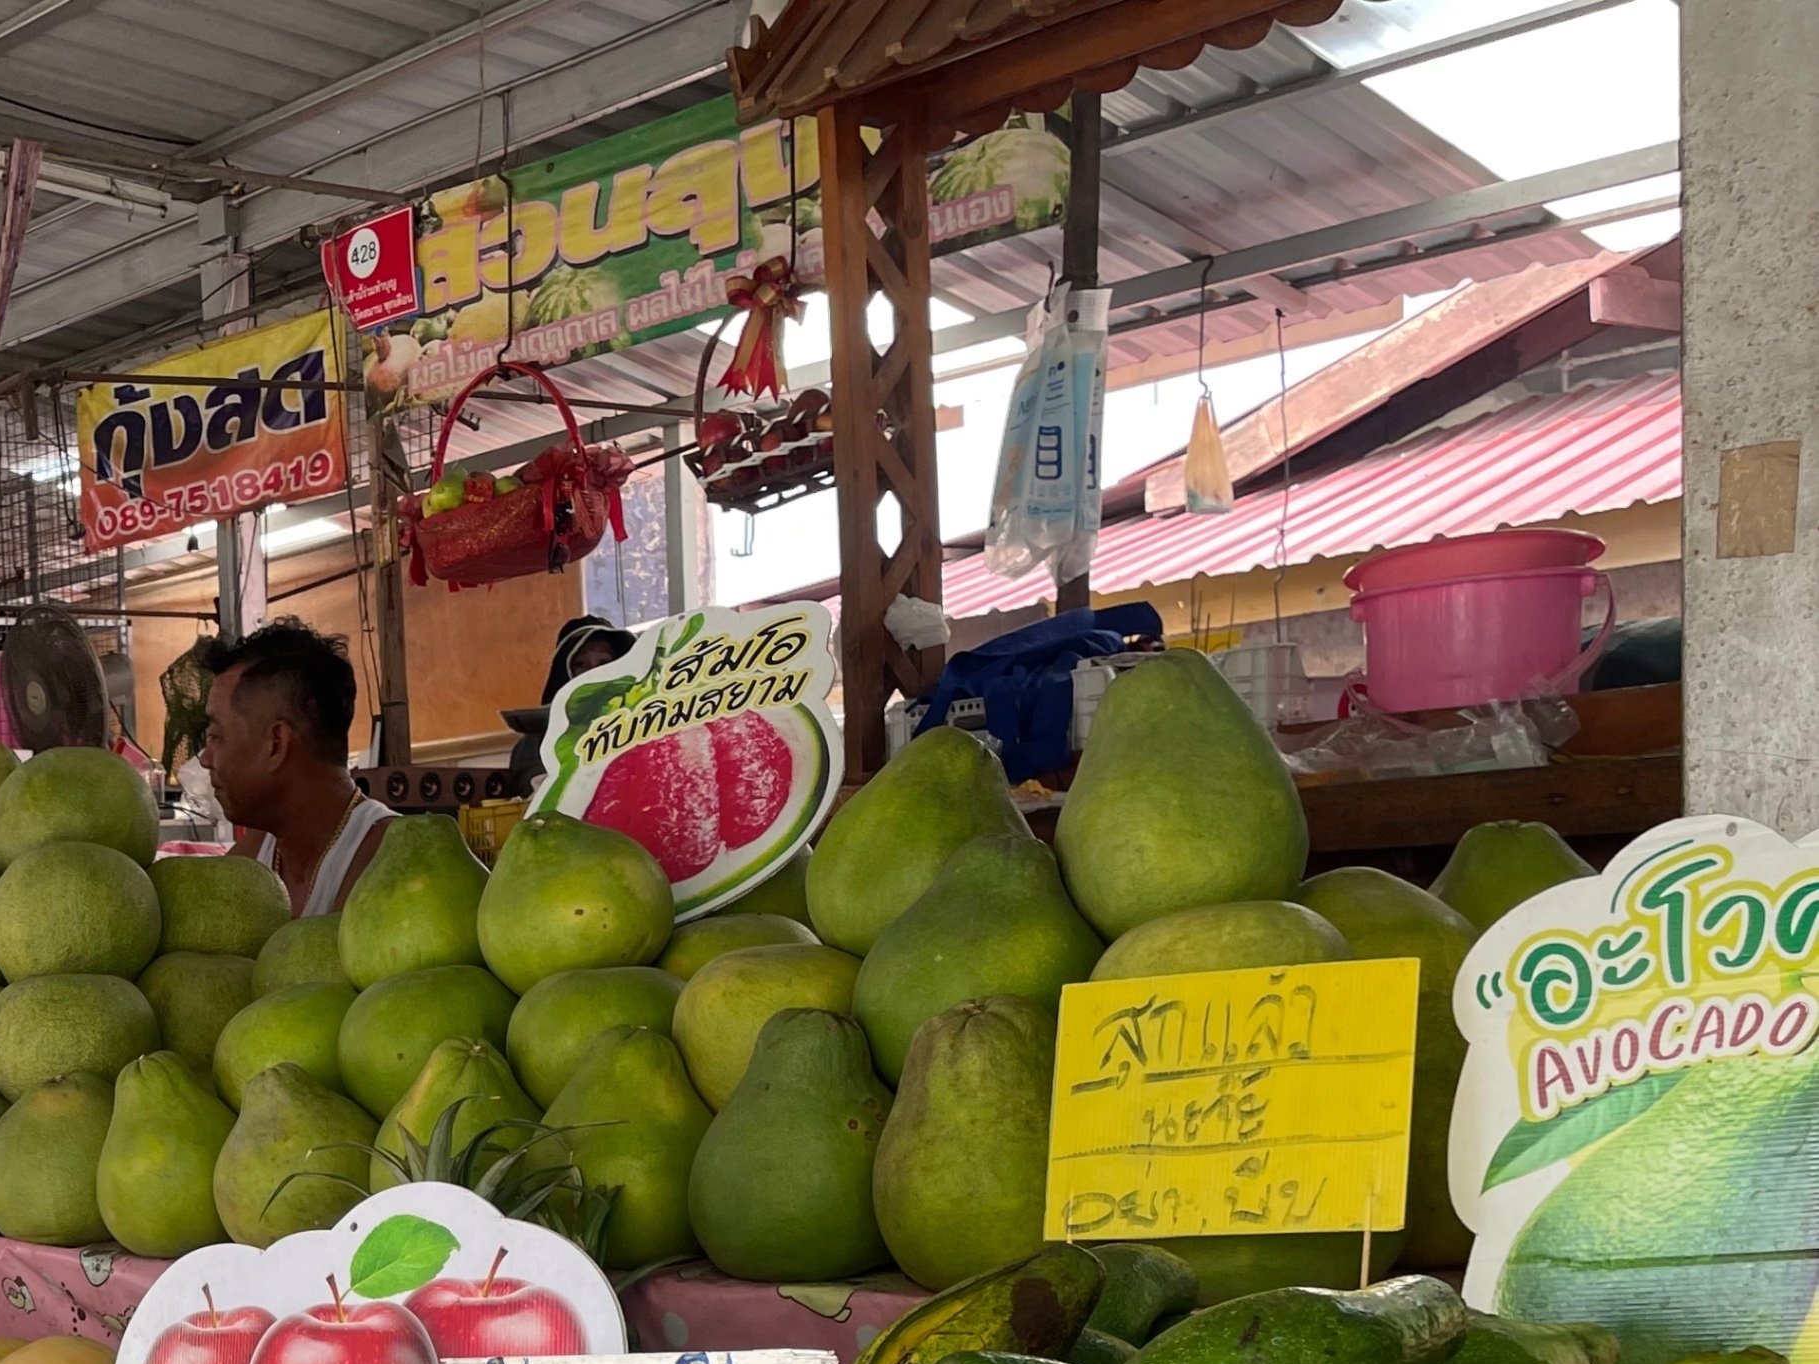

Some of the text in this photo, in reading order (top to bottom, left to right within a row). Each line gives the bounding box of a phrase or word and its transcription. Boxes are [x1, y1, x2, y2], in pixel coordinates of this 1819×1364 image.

[351, 241, 377, 264] 428
[93, 349, 328, 499] กุ้งสด
[97, 450, 333, 540] 089-7518419
[665, 617, 807, 691] ส้มโอ
[582, 671, 810, 763] ทับทิมสยาม
[1535, 1002, 1810, 1109] AVOCADO
